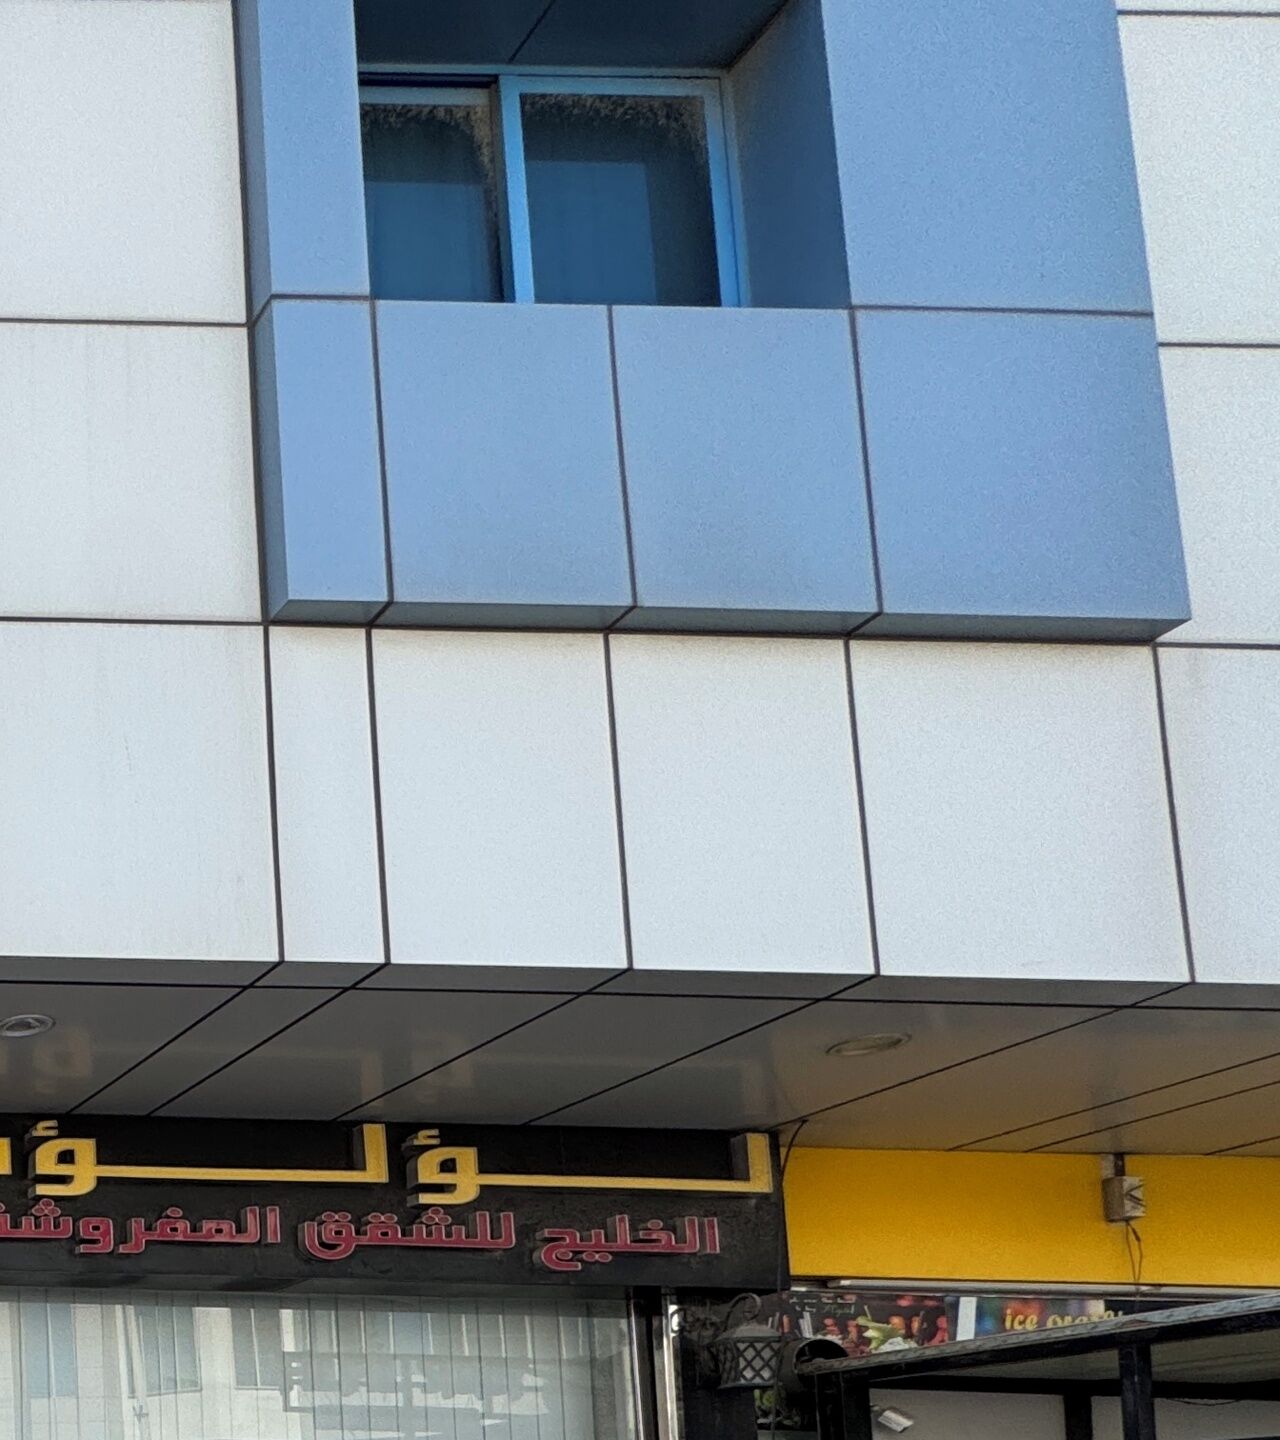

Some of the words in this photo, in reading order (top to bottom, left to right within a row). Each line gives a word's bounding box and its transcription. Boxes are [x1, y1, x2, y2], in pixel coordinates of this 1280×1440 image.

[296, 1205, 516, 1262] للشقق
[535, 1213, 721, 1272] الخليج
[1004, 1308, 1039, 1331] ice
